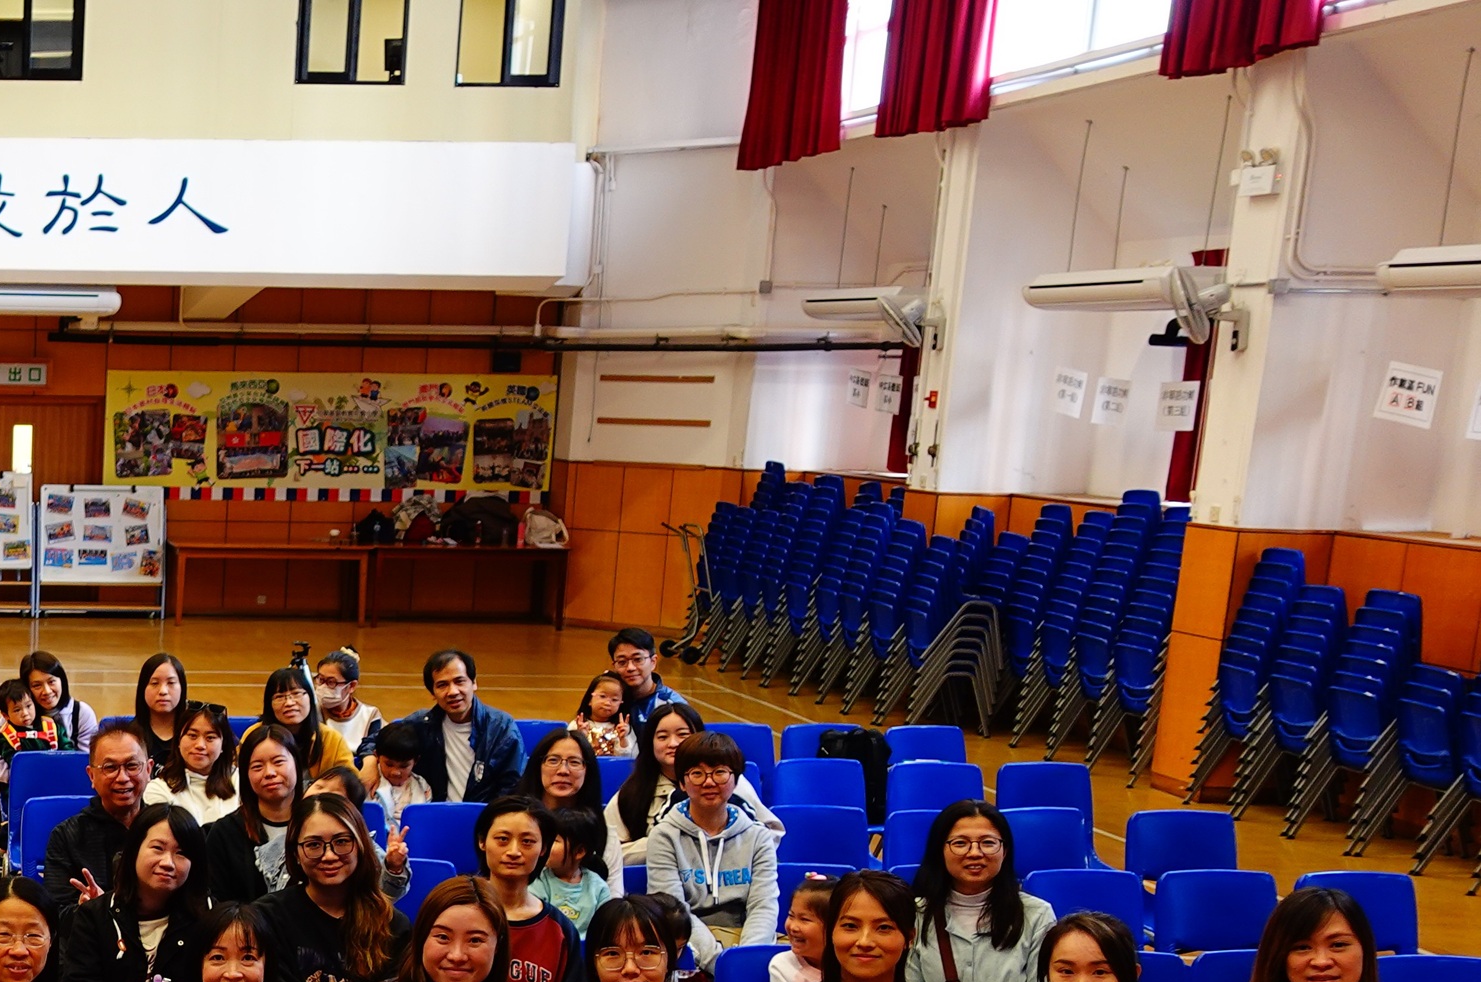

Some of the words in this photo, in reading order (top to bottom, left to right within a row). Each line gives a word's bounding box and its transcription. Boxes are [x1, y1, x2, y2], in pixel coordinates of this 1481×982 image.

[8, 367, 41, 382] 出口
[1416, 381, 1436, 396] FUN
[297, 427, 374, 454] 國際化
